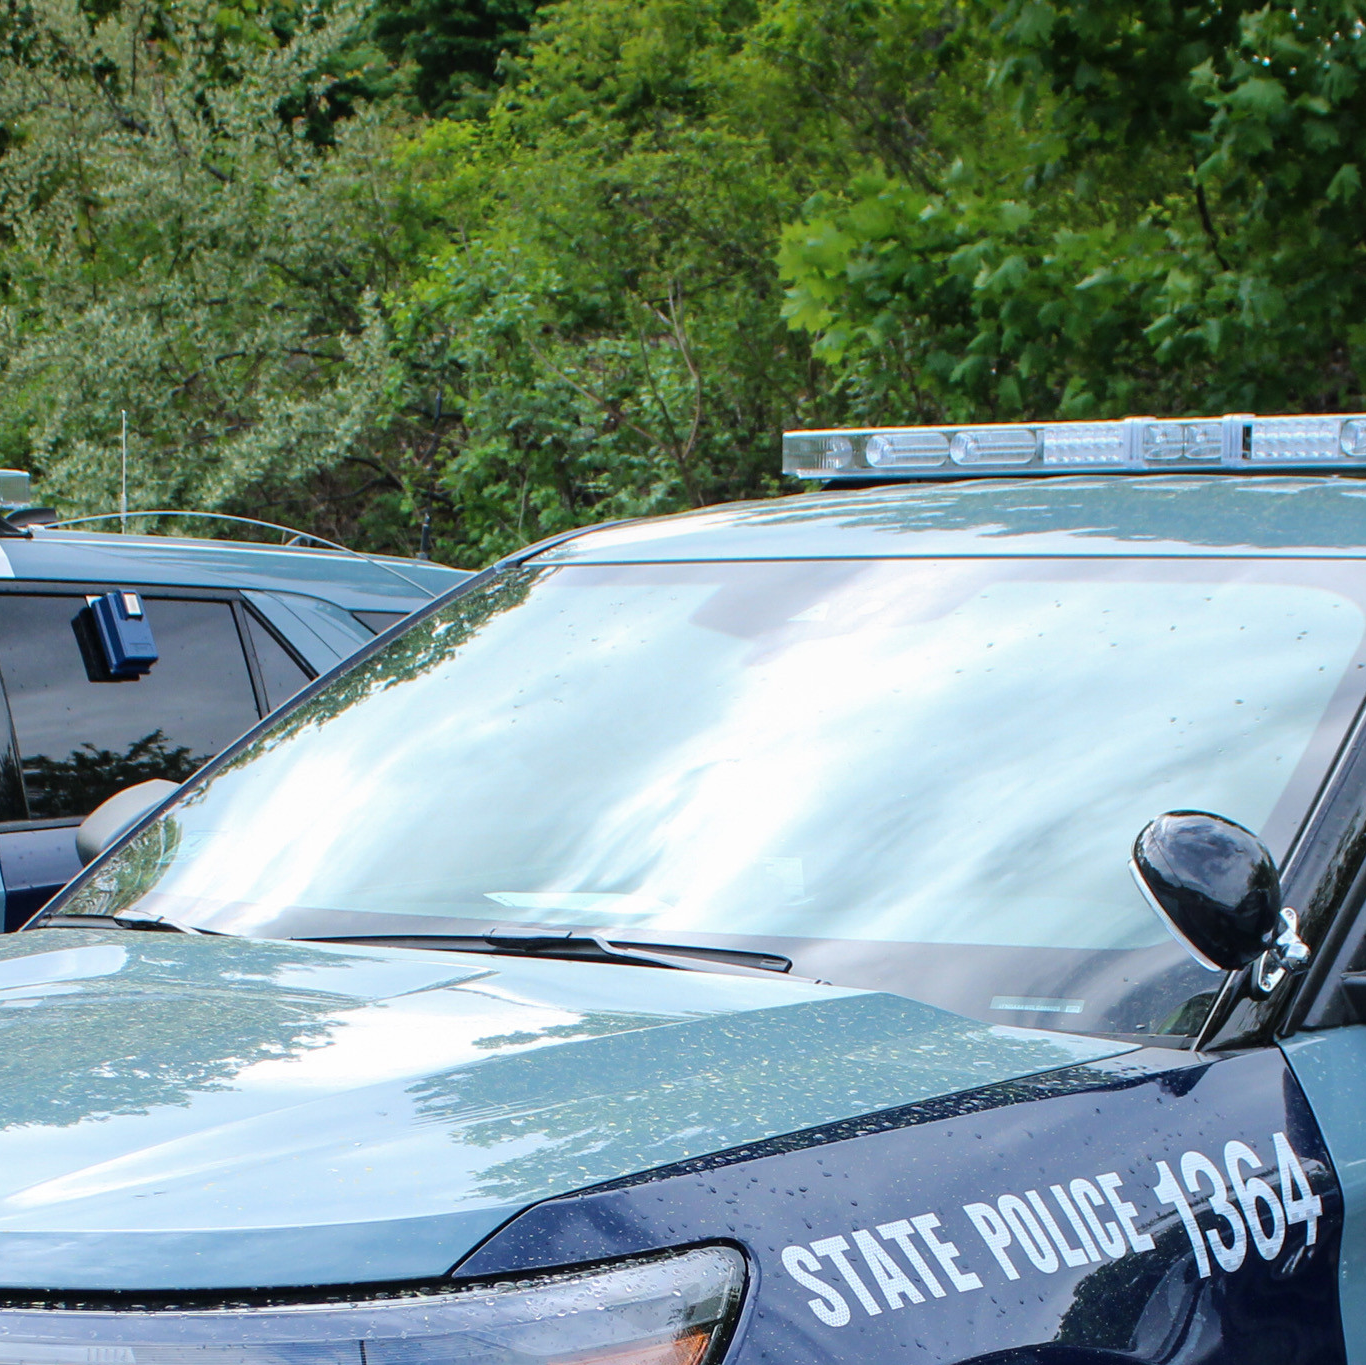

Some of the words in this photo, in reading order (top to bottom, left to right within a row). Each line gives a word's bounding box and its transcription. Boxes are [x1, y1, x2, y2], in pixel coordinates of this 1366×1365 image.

[780, 1212, 984, 1328] STATE
[962, 1171, 1158, 1282] POLICE
[1152, 1131, 1324, 1279] 1364
